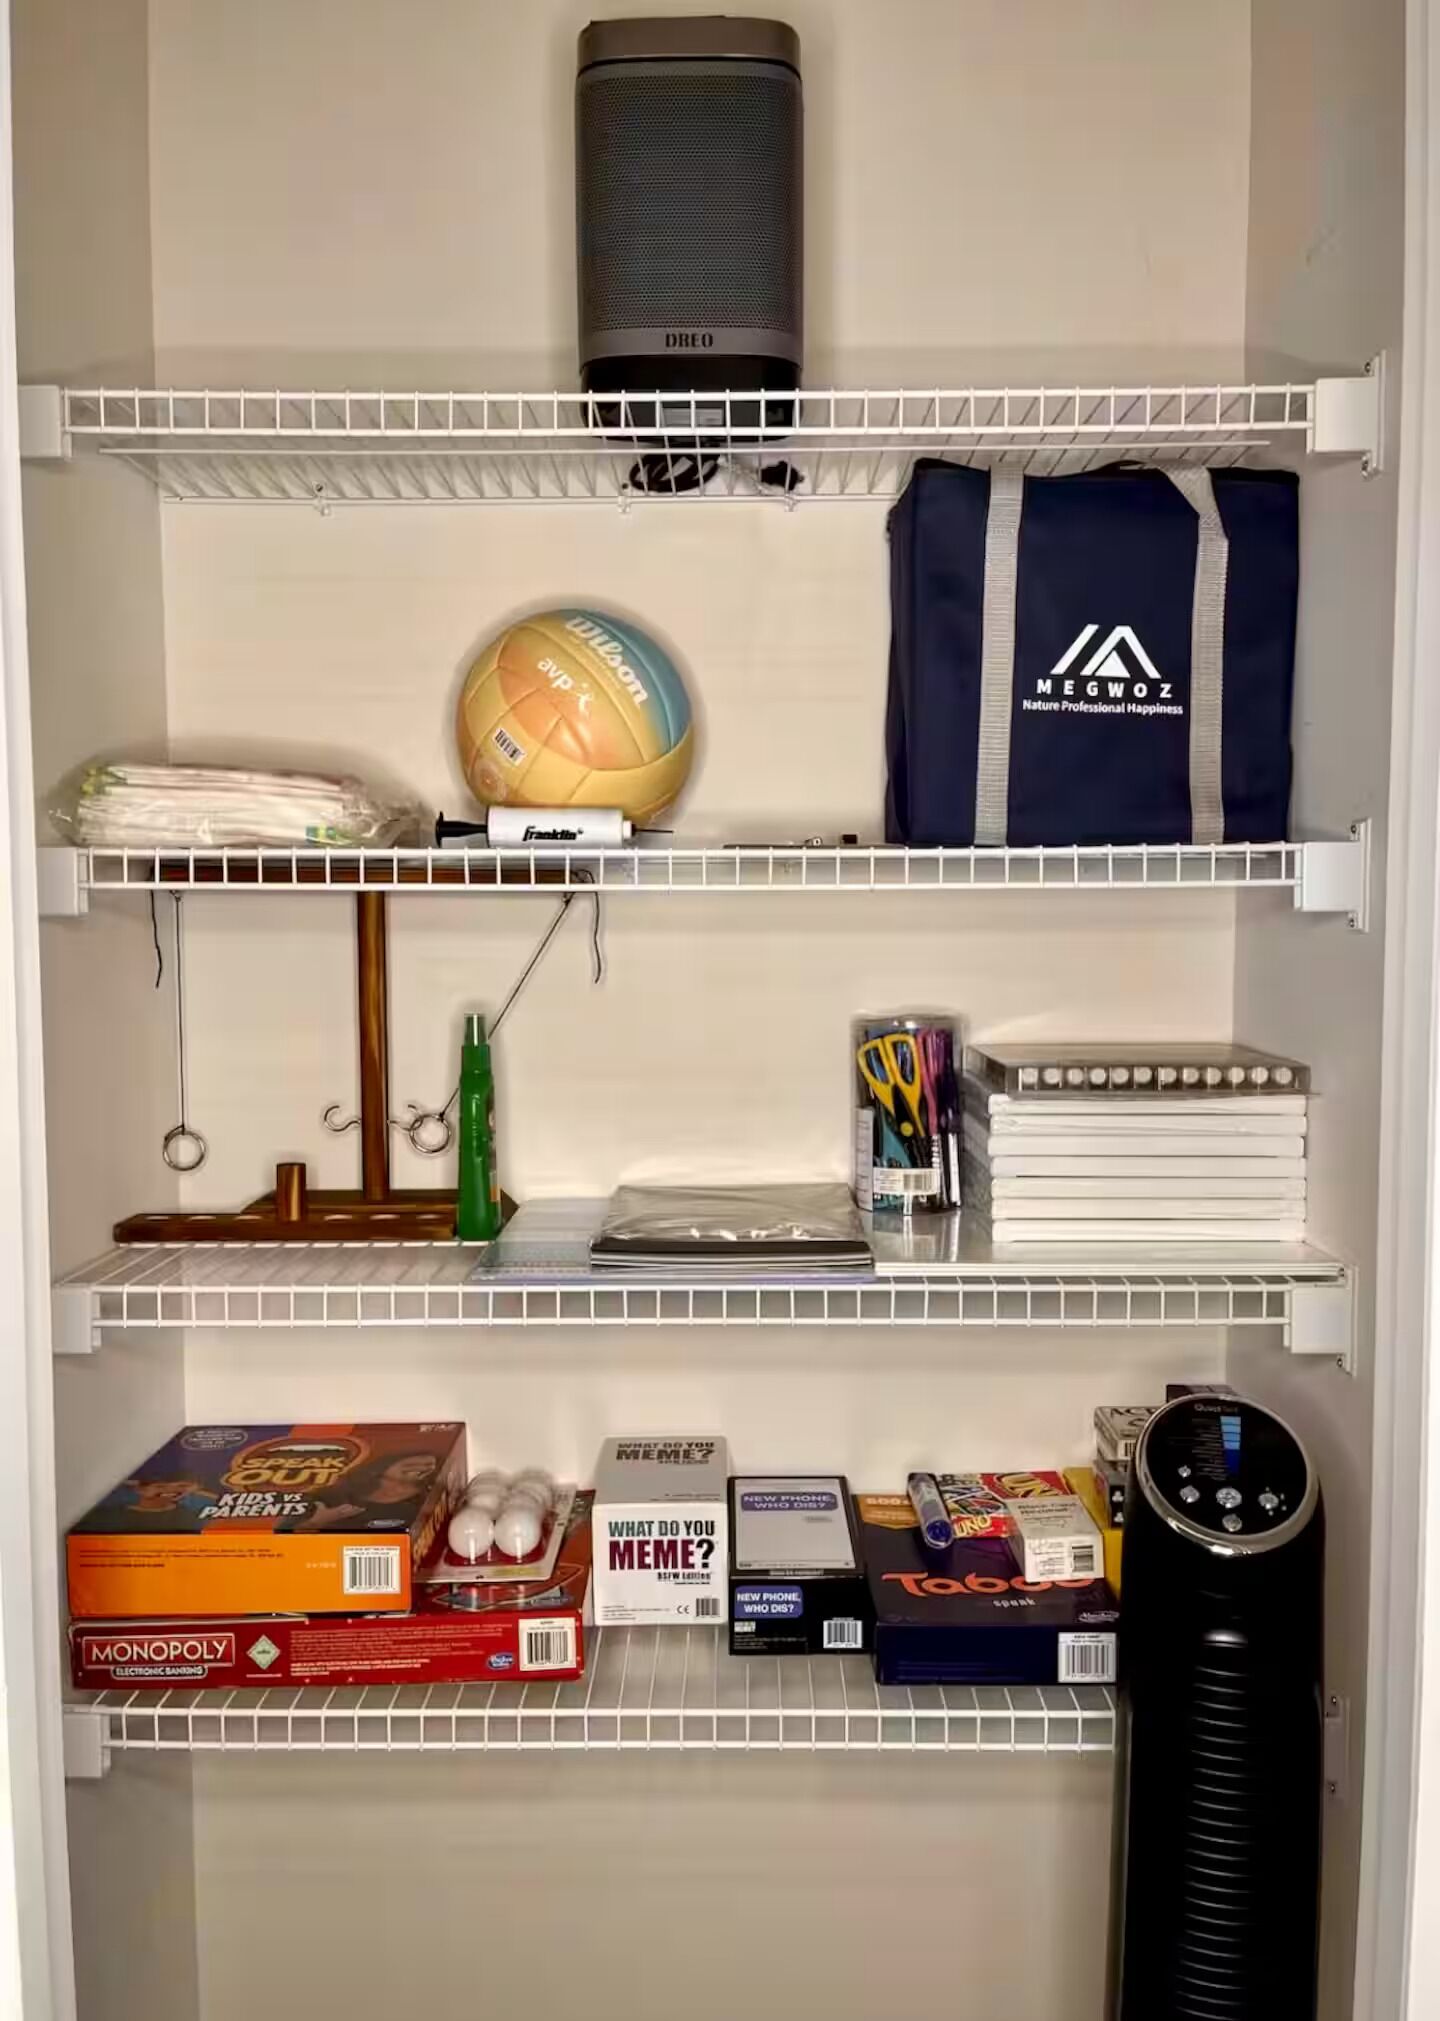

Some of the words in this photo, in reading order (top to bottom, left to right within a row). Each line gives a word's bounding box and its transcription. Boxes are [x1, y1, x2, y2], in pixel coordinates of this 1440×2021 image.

[665, 333, 714, 348] DREO
[565, 616, 649, 705] Wilson
[536, 657, 575, 690] avp
[1036, 679, 1173, 698] MEGWOZ
[1022, 699, 1060, 711] Nature
[1061, 701, 1125, 714] Professional
[1127, 703, 1183, 716] Happiness
[242, 1456, 345, 1468] SPEAK
[616, 1449, 715, 1461] MEME?
[227, 1468, 340, 1486] OUT
[218, 1492, 277, 1505] KIDS
[199, 1503, 309, 1519] PARENTS
[608, 1520, 654, 1537] WHAT
[658, 1520, 680, 1537] DO
[683, 1520, 715, 1536] YOU
[954, 1515, 993, 1537] UNO
[609, 1538, 715, 1570] MEME?
[736, 1592, 761, 1602] NEW
[744, 1604, 769, 1613] WHO
[771, 1604, 795, 1613] DIS?
[92, 1640, 228, 1662] MONOPOLY
[115, 1667, 164, 1676] ELECTRONIC
[165, 1666, 203, 1675] BANKING
